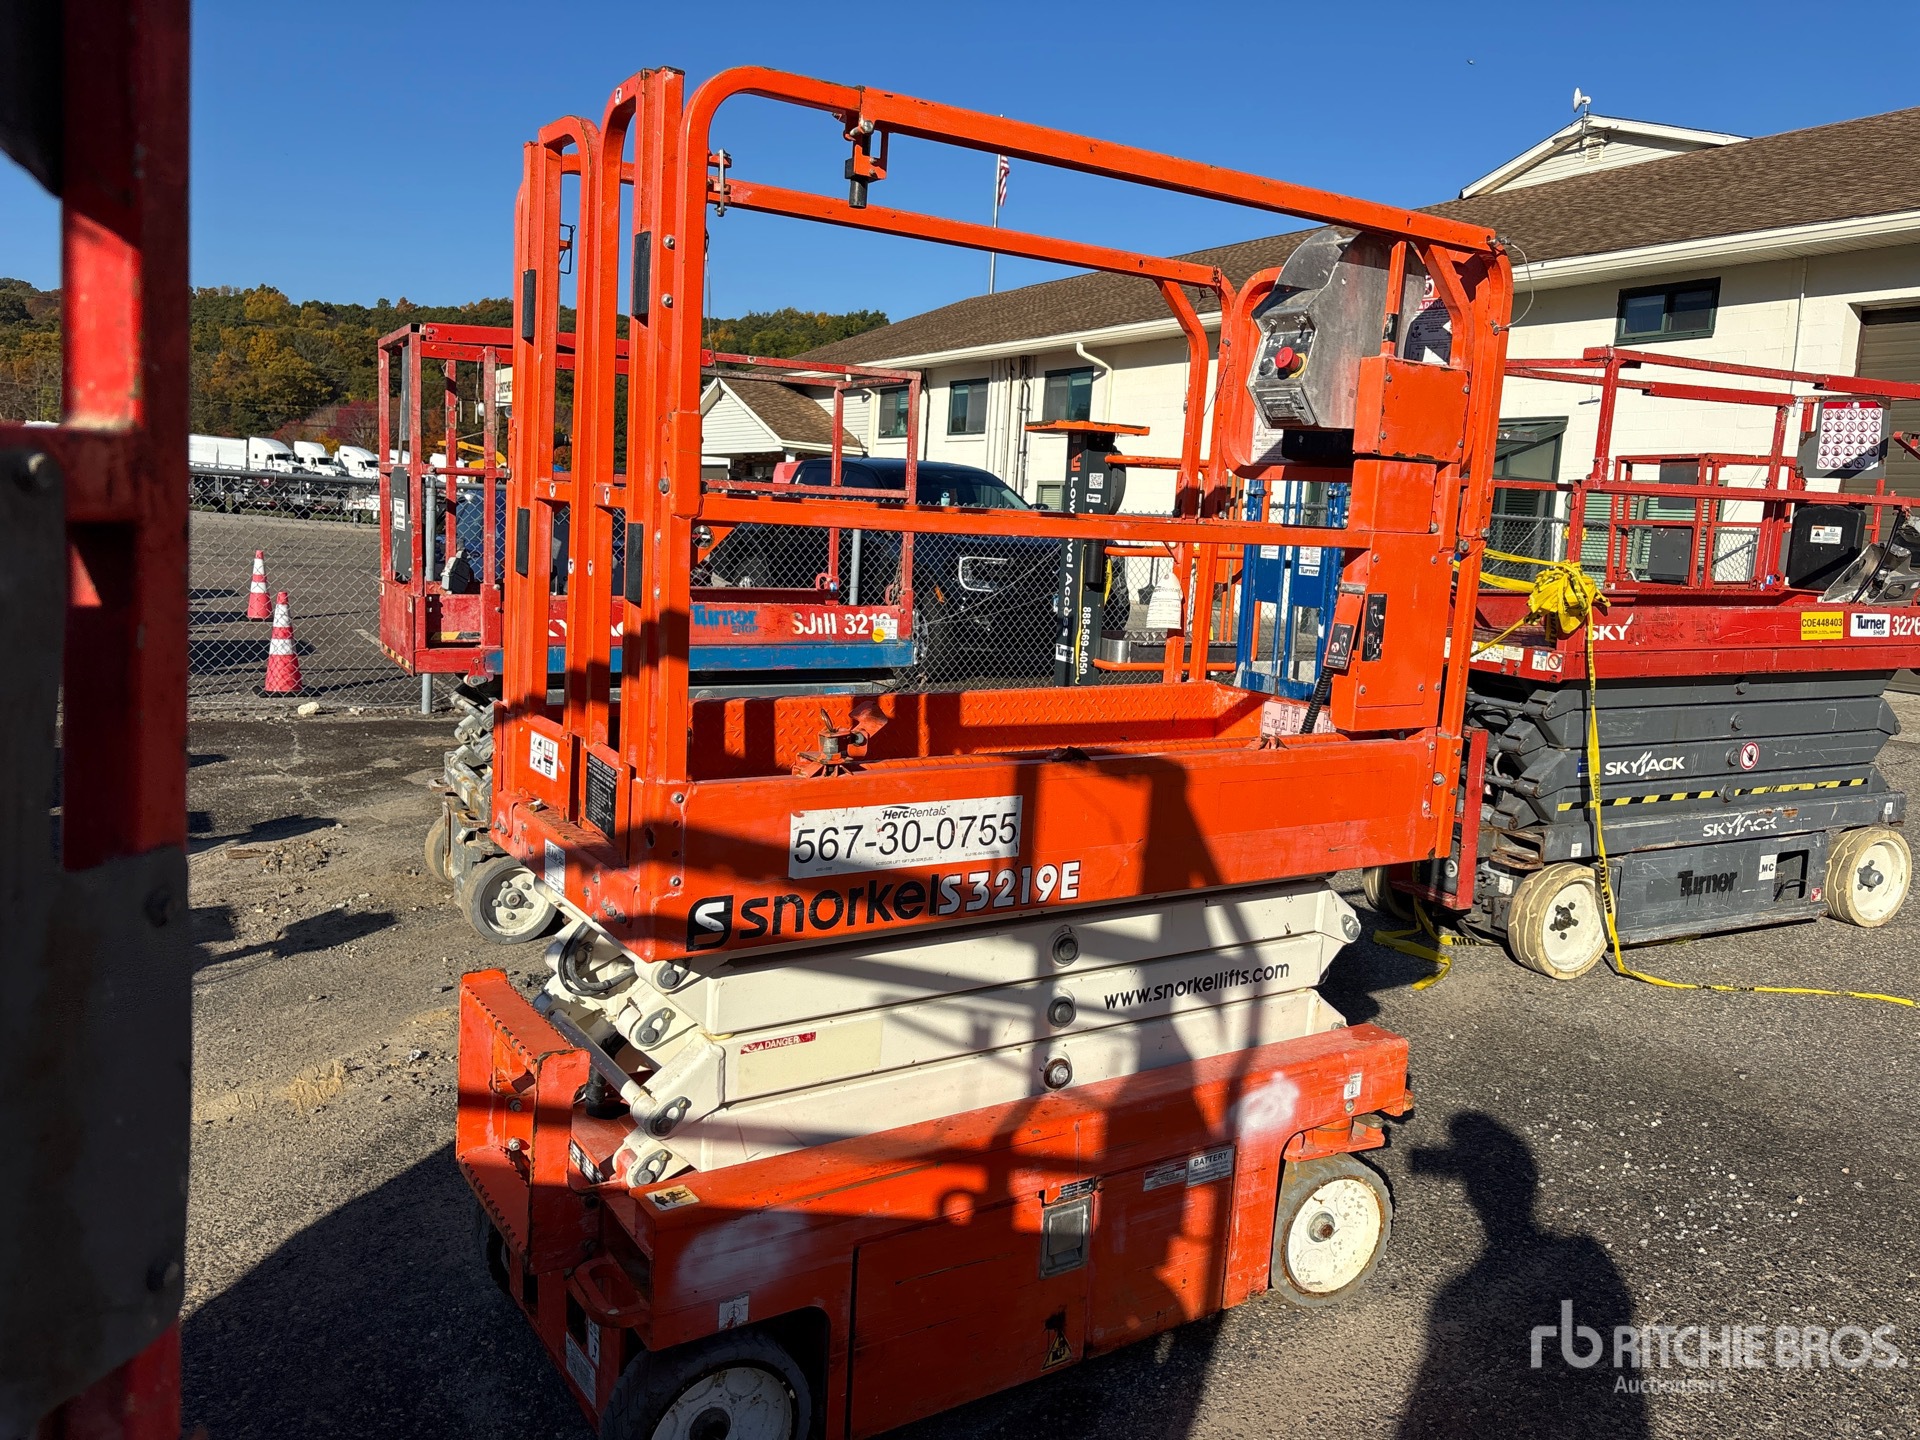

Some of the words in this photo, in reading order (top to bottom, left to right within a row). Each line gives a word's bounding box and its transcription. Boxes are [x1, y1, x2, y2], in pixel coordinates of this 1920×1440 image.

[1802, 618, 1843, 627] COE448403
[1856, 615, 1886, 630] Turner
[1079, 606, 1092, 674] 888-569-4050
[1604, 751, 1685, 777] SKYJACK
[1703, 814, 1778, 837] SKYJACK
[794, 812, 1017, 864] 567-30-0755
[1761, 862, 1774, 873] MC
[739, 873, 938, 940] snorkel
[938, 861, 1081, 916] S3219E
[1103, 963, 1290, 1010] www.snorkellifts.com
[764, 1036, 800, 1050] DANGER
[1193, 1151, 1228, 1167] BATTERY
